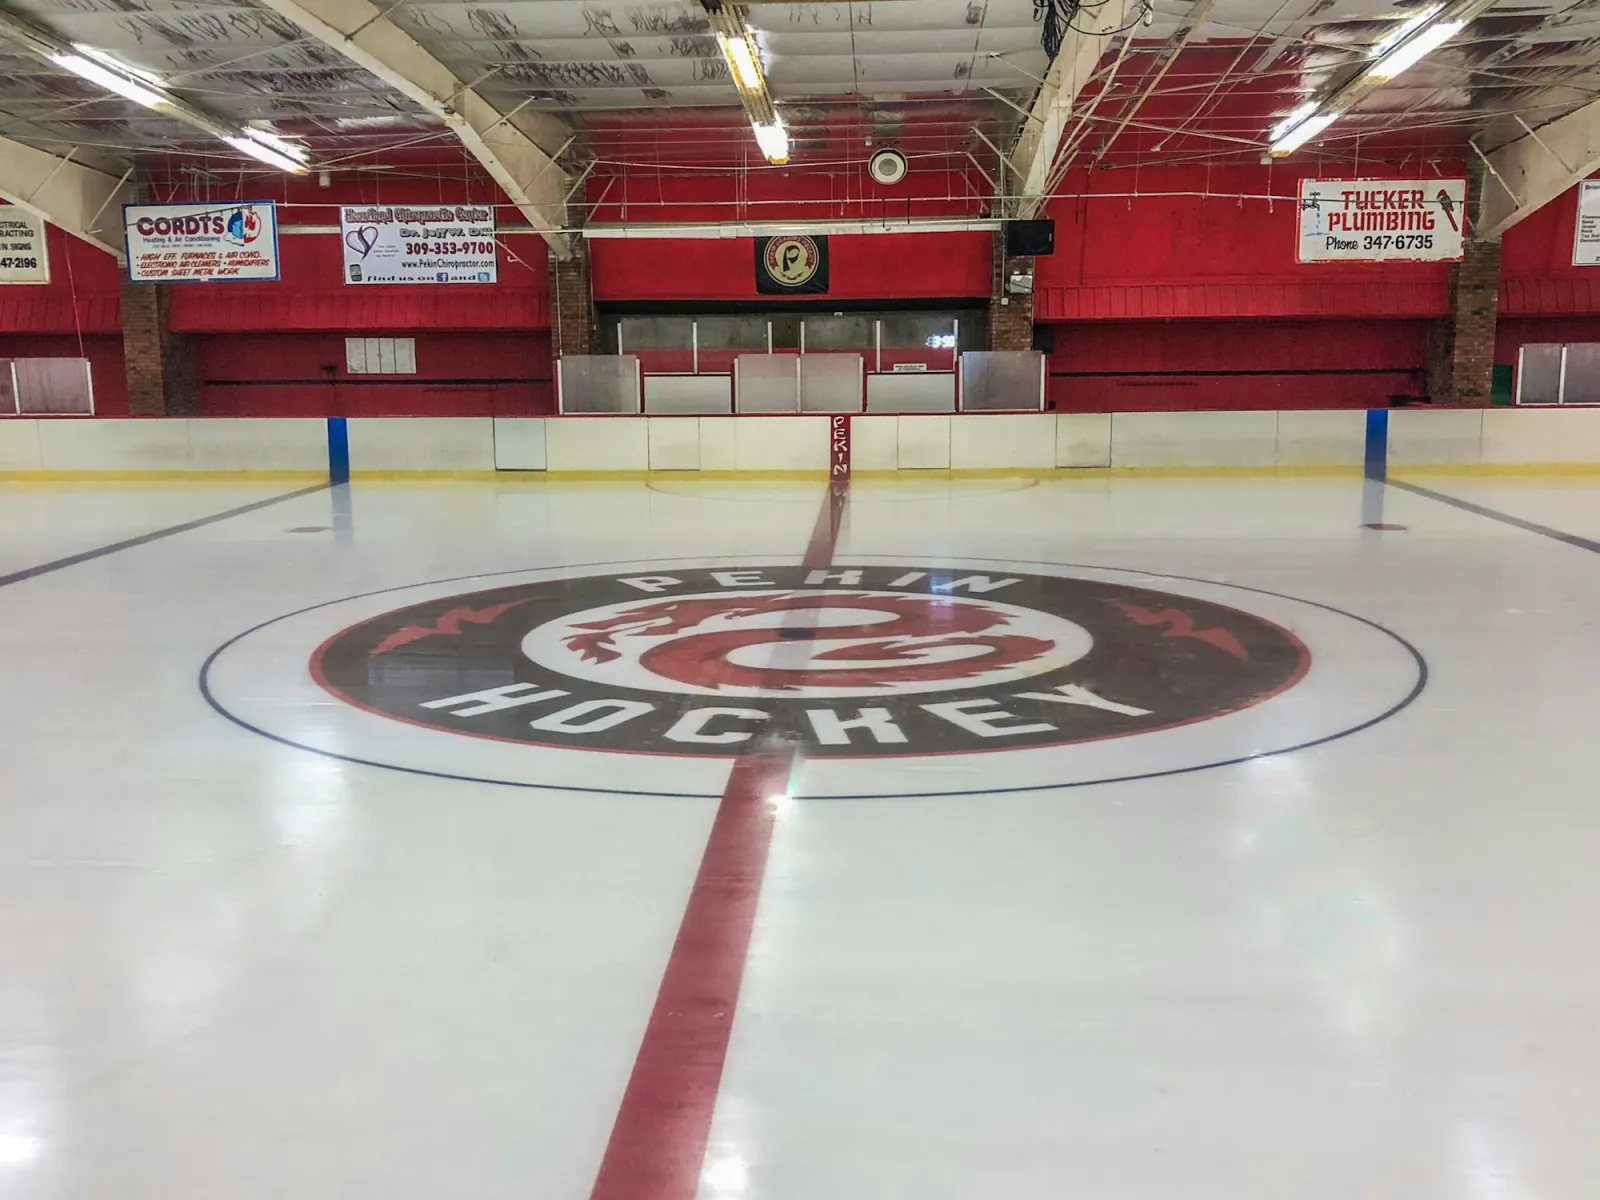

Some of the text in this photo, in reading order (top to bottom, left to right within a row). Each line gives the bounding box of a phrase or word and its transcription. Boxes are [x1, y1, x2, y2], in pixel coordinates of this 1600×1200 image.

[1341, 189, 1425, 211] TUCKER
[344, 207, 394, 225] Heartland
[394, 207, 455, 225] Chiropractic
[1327, 210, 1436, 232] PLUMBING
[136, 214, 225, 236] CORDTS
[399, 228, 421, 238] Dr.
[405, 241, 494, 255] 309-353-9700
[1326, 235, 1359, 250] Phone
[163, 252, 177, 260] EFF.
[181, 251, 216, 259] FURNACES
[239, 250, 261, 258] COND.
[140, 261, 177, 269] ELECTRONIC
[227, 259, 270, 267] HUMIDIFIERS
[401, 258, 494, 270] www.PekinChiropractor.com
[141, 267, 240, 277] CUSTOM SHEET METAL WORK
[833, 416, 848, 475] PEKIN
[418, 682, 1154, 744] HOCKEY
